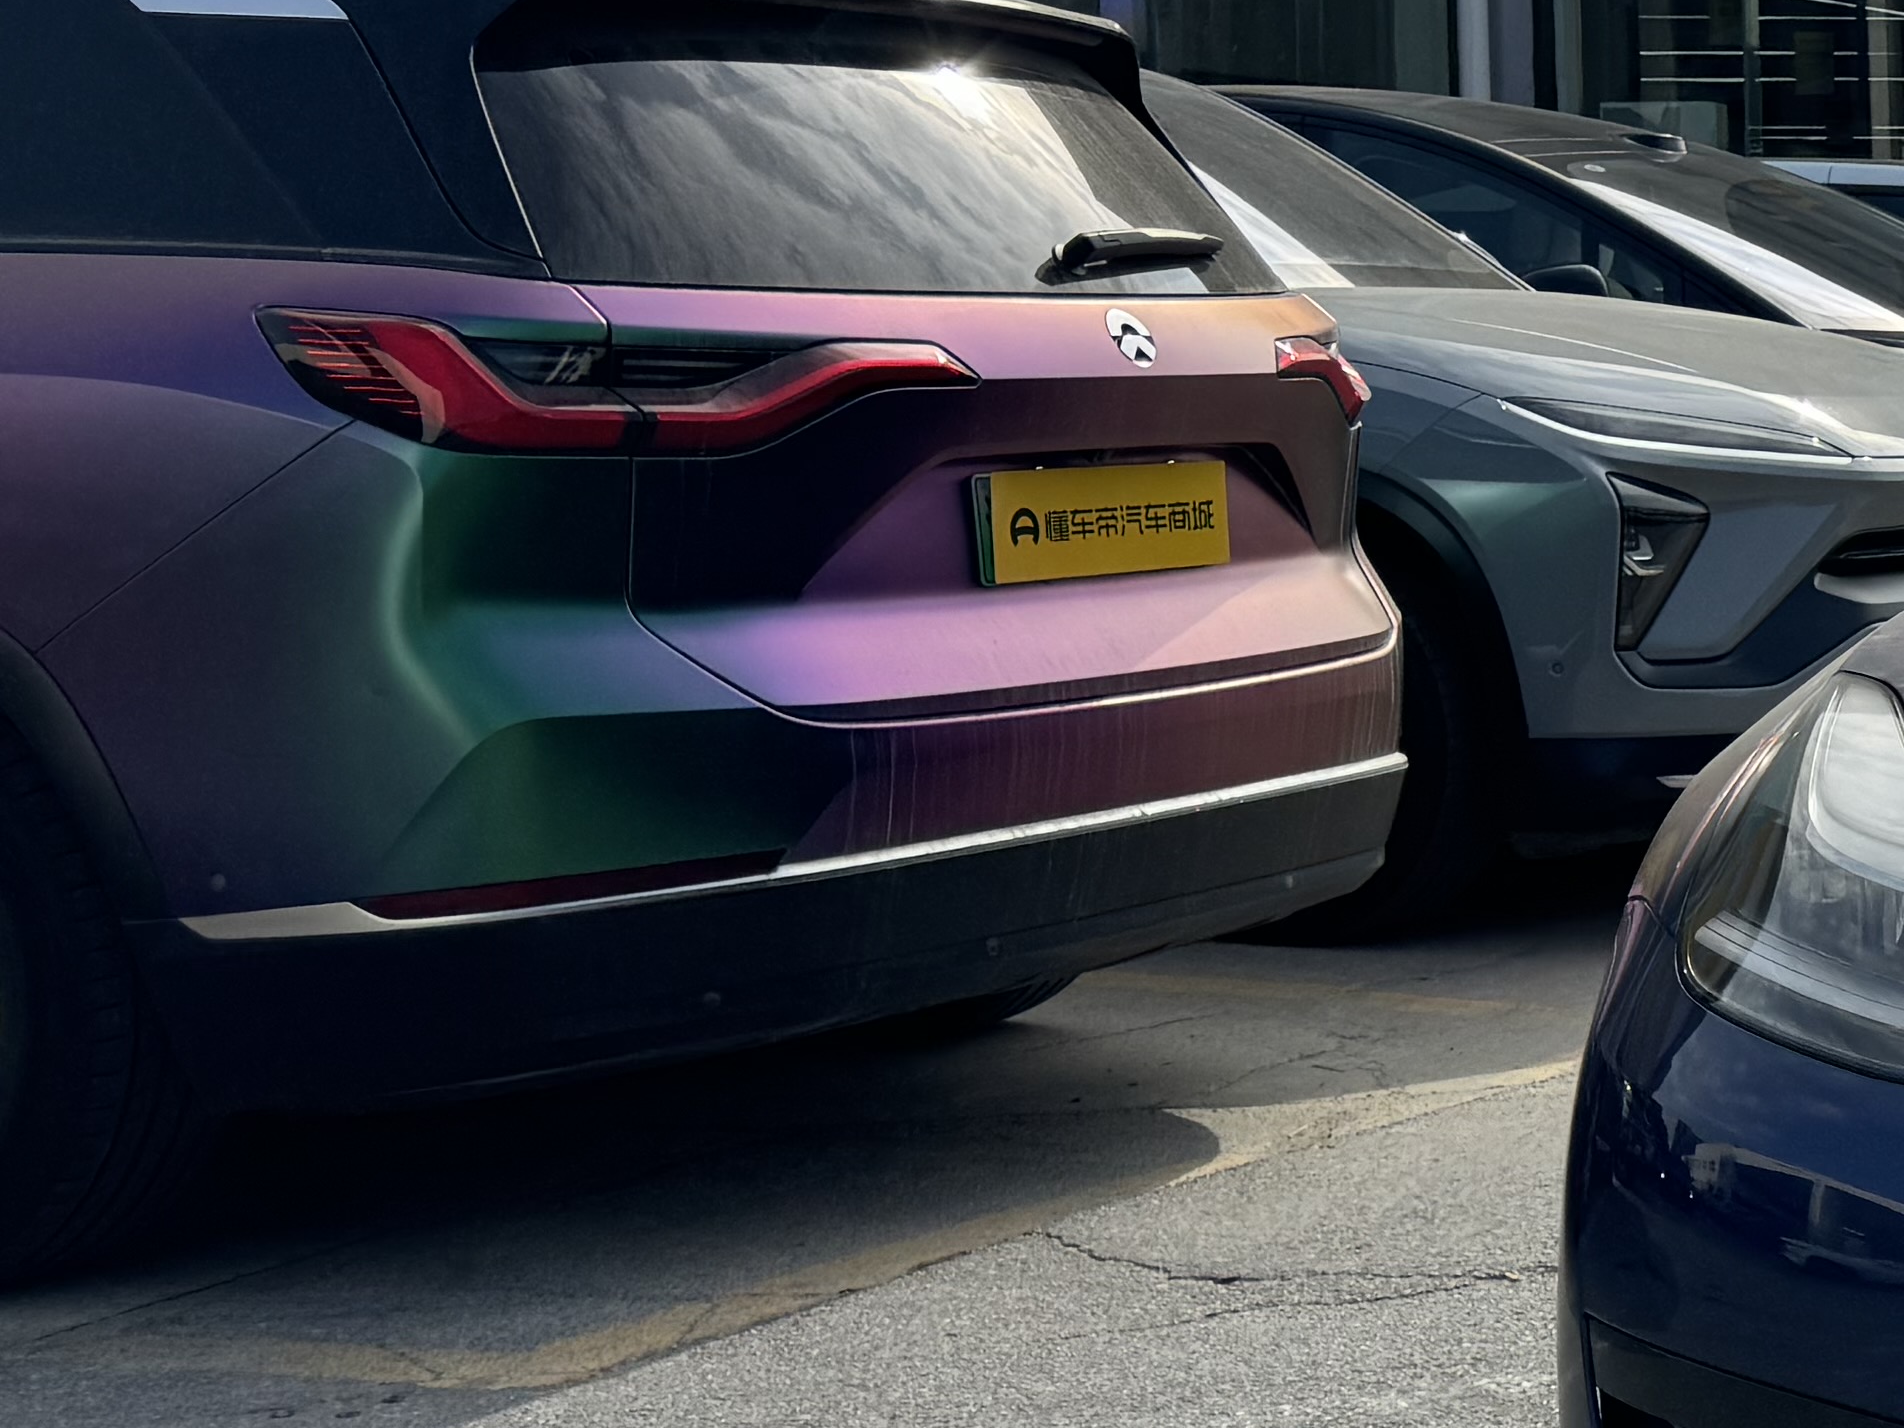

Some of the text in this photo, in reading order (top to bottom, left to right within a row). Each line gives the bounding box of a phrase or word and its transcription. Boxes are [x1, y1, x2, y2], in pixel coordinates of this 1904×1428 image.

[1044, 499, 1215, 542] 懂车帝汽车商城
